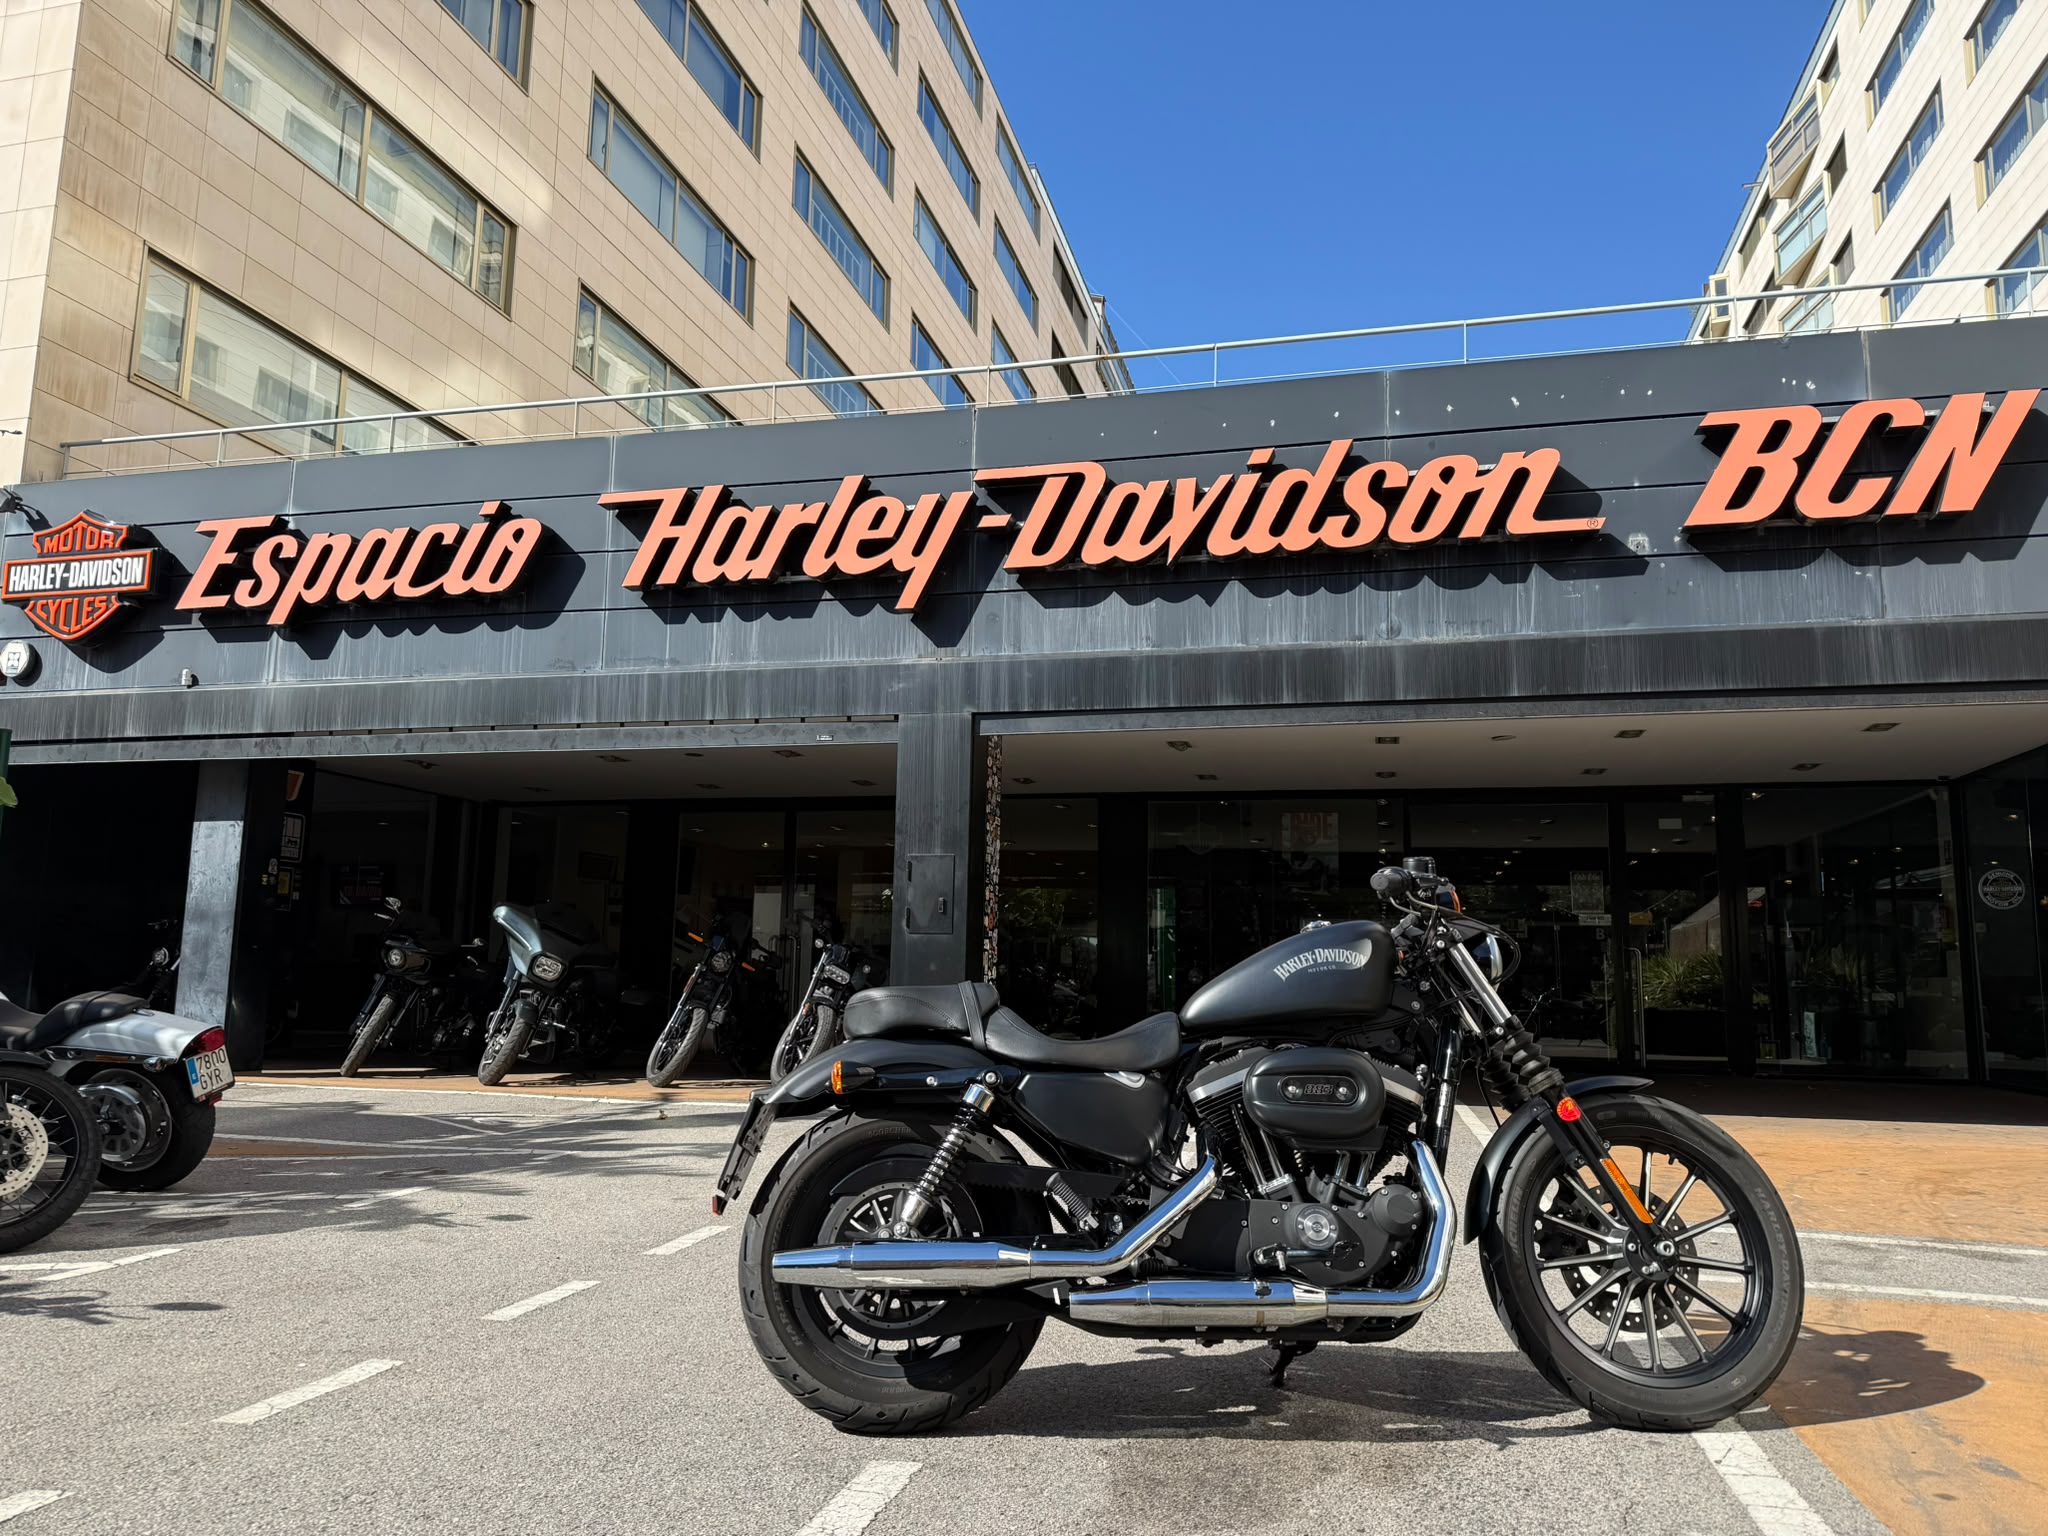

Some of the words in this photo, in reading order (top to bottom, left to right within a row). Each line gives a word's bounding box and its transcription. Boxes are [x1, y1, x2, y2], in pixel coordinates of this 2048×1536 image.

[175, 500, 542, 625] Espacio
[597, 439, 1606, 611] Harley-Davidson
[1683, 388, 2041, 527] BCN
[44, 521, 116, 554] MOTOR
[8, 557, 145, 592] HARLEY-DAVIDSON
[36, 596, 108, 633] CYCLES
[196, 1048, 227, 1073] 7800
[199, 1068, 223, 1090] GYR
[1304, 1084, 1334, 1095] 883
